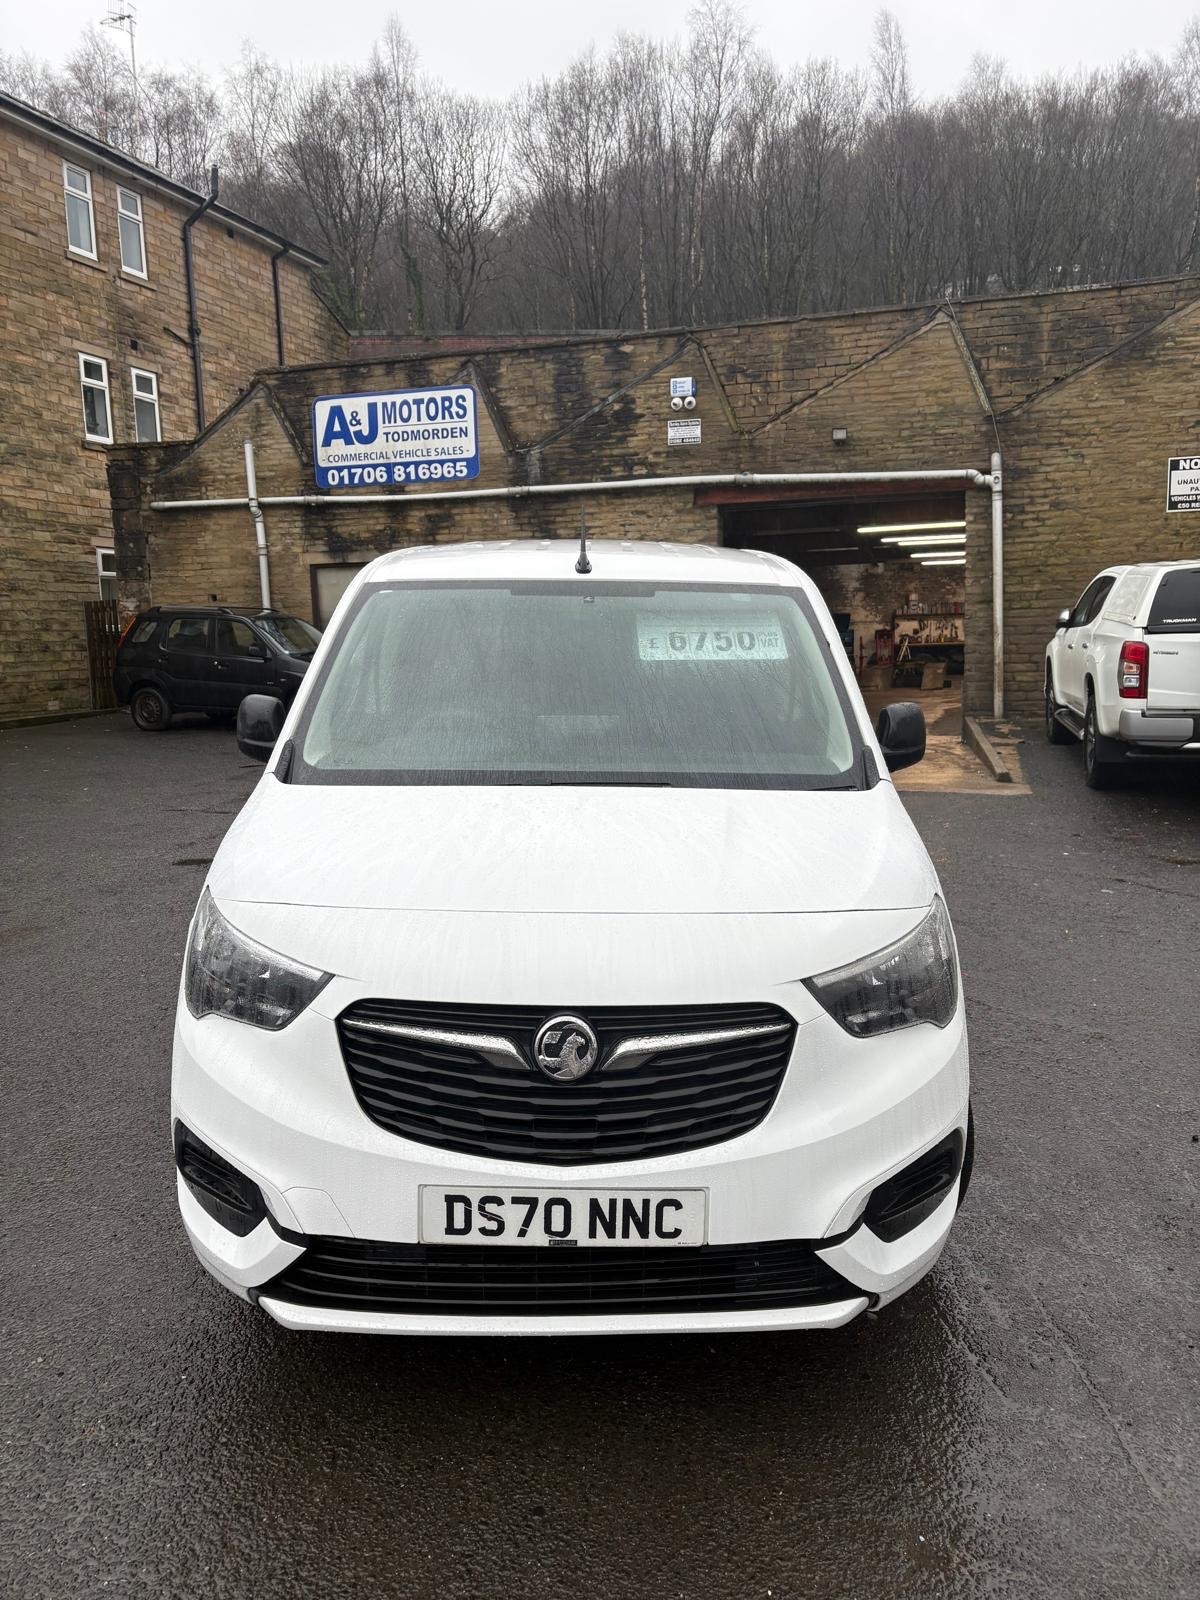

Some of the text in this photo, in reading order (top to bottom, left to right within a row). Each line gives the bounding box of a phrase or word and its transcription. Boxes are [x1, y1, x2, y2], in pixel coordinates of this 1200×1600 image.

[382, 394, 468, 425] MOTORS
[321, 402, 379, 448] A&J
[383, 426, 468, 443] TODMORDEN
[327, 445, 464, 463] COMMERCIAL VEHICLE SALES
[327, 461, 468, 486] 01706 816965
[668, 631, 757, 651] 6750
[444, 1194, 683, 1239] DS70 NNC
